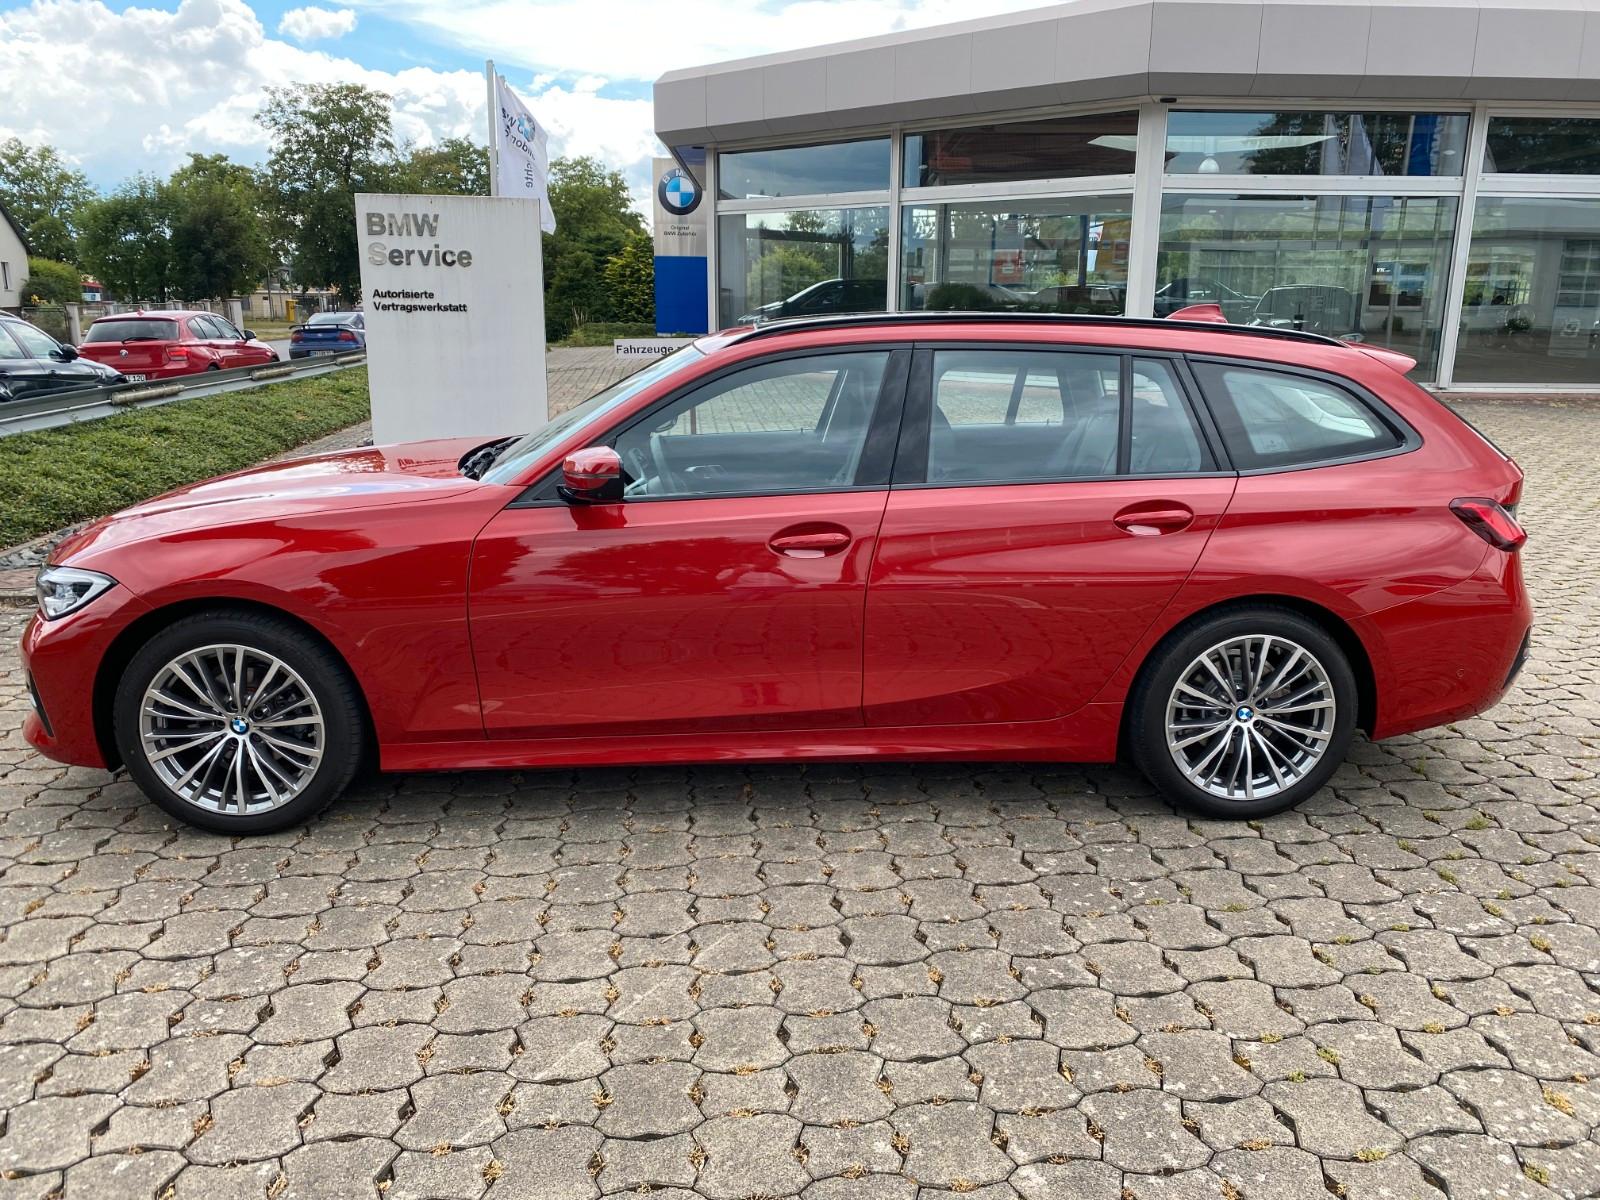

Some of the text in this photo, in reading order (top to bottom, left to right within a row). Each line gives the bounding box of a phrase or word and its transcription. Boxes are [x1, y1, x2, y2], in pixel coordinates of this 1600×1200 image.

[366, 212, 440, 237] BMW
[367, 241, 473, 268] Service
[372, 289, 435, 300] Autorisierte
[373, 301, 468, 313] Vertragswerkstatt
[616, 344, 674, 356] Fahrzeuge
